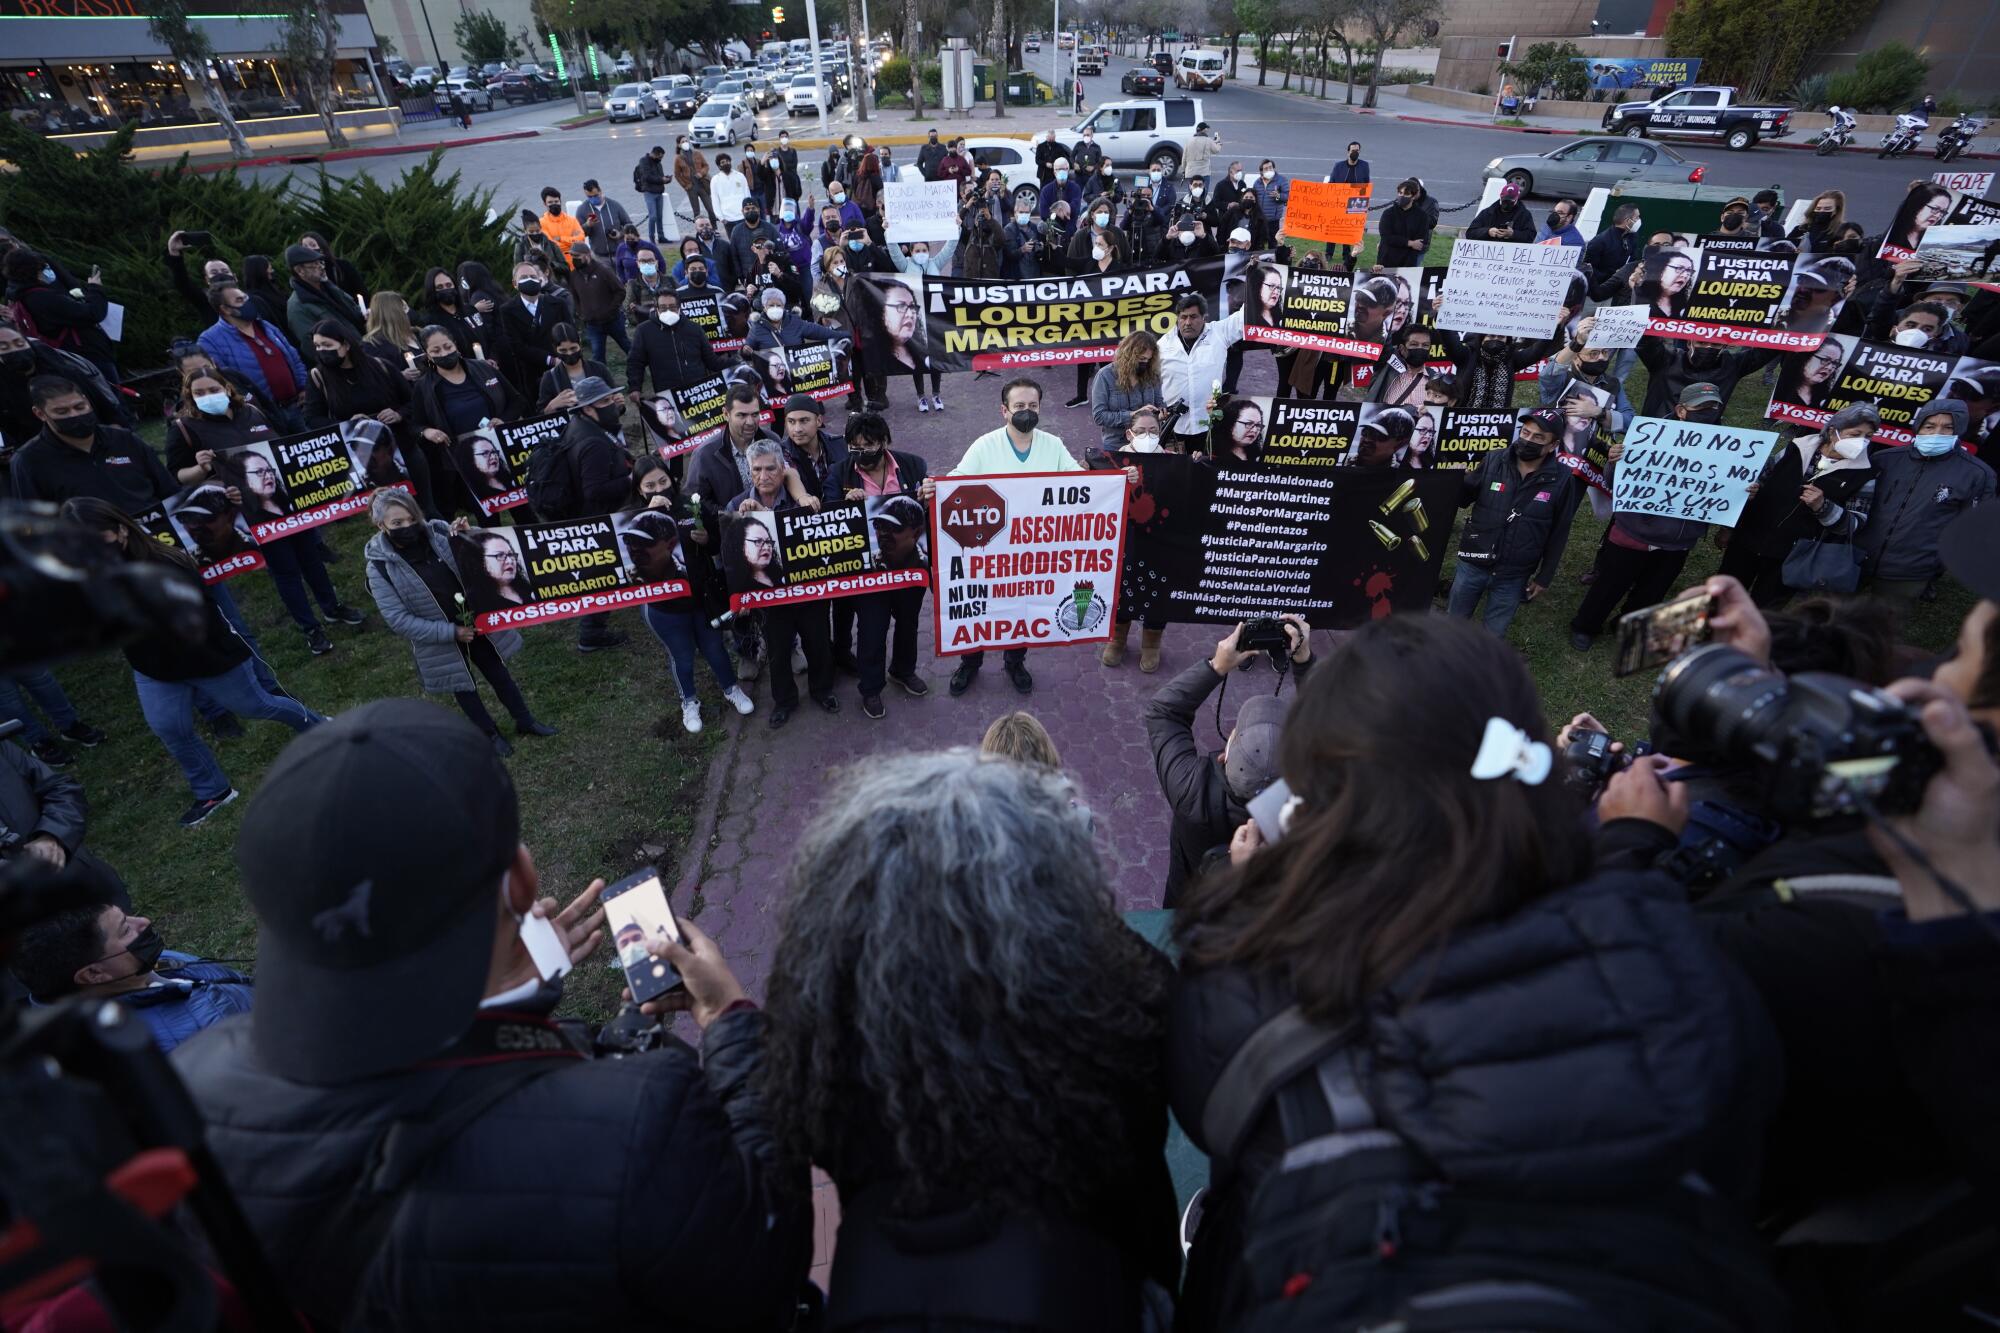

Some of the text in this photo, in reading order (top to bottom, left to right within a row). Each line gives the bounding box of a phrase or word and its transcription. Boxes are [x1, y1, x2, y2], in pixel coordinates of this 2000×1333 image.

[1651, 62, 1687, 72] ODISEA
[1650, 113, 1717, 124] POLICÍA MUNICIPAL
[1951, 173, 1991, 190] GOLPE
[1453, 259, 1468, 267] CON
[1457, 242, 1579, 267] MARINA DEL PILAR
[1707, 255, 1789, 271] ¡JUSTICIA
[1292, 271, 1350, 287] ¡JUSTICIA
[1451, 269, 1461, 277] TE
[1491, 275, 1525, 286] CIENTOS
[1723, 269, 1772, 281] PARA
[928, 270, 1192, 313] ¡JUSTICIA PARA
[1303, 286, 1338, 298] PARA
[1448, 288, 1469, 297] BAJA
[1516, 288, 1560, 298] CORAZONES
[1698, 281, 1782, 298] LOURDES
[683, 305, 709, 317] PARA
[955, 293, 1174, 327] LOURDES
[1287, 297, 1346, 313] LOURDES
[1729, 299, 1738, 307] Y
[1310, 312, 1317, 320] Y
[1688, 304, 1778, 325] MARGARITO!
[1284, 317, 1346, 335] MARGARITO!
[1647, 318, 1822, 347] YoSíSoyPeriodista
[1247, 326, 1380, 356] #YoSíSoyPeriodista
[1590, 333, 1636, 344] A PSN
[789, 344, 828, 363] ¡JUSTICIA
[800, 353, 823, 365] PARA
[1856, 346, 1948, 374] ¡JUSTICIA
[793, 361, 831, 377] LOURDES
[1870, 365, 1924, 385] PARA
[676, 377, 723, 404] ¡JUSTICIA
[795, 372, 834, 393] MARGARITO!
[1841, 376, 1933, 403] LOURDES
[690, 388, 718, 405] PARA
[1873, 396, 1882, 406] Y
[1277, 404, 1355, 425] ¡JUSTICIA
[1446, 412, 1513, 429] ¡JUSTICIA
[502, 416, 567, 447] ¡JUSTICIA
[1292, 422, 1338, 435] PARA
[1459, 425, 1499, 437] PARA
[278, 432, 340, 464] ¡JUSTICIA
[1270, 434, 1348, 449] LOURDES
[1441, 439, 1508, 451] LOURDES
[1673, 429, 1702, 448] NO
[1706, 433, 1764, 459] NOS
[297, 448, 335, 467] PARA
[1263, 453, 1344, 467] MARGARITO!
[1624, 449, 1718, 480] UNIMOS
[1727, 465, 1759, 483] NOS
[287, 457, 350, 487] LOURDES
[1217, 470, 1334, 489] #LourdesMaldonado
[1621, 468, 1725, 495] MATARAN
[295, 471, 363, 509] MARGARITO!
[318, 479, 325, 487] Y
[1042, 486, 1091, 506] A LOS
[1215, 487, 1331, 506] #MargaritoMartinez
[1659, 490, 1681, 507] X
[1684, 494, 1730, 512] UNO
[947, 508, 1000, 526] ALTO
[1210, 503, 1330, 522] #UnidosPorMargarito
[1614, 500, 1676, 515] PARQUE
[783, 506, 862, 536] ¡JUSTICIA
[1009, 512, 1118, 545] ASESINATOS
[1226, 520, 1308, 536] #Pendientazos
[524, 522, 610, 550] ¡JUSTICIA
[803, 522, 850, 541] PARA
[548, 536, 600, 555] PARA
[786, 535, 865, 562] LOURDES
[1200, 534, 1327, 553] #JusticiaParaMargarito
[531, 549, 617, 576] LOURDES
[788, 552, 871, 583] MARGARITO!
[821, 556, 830, 565] Y
[950, 549, 1113, 581] A PERIODISTAS
[1204, 551, 1319, 566] #JusticiaParaLourdes
[571, 571, 580, 580] Y
[1204, 566, 1311, 580] #NiSilencioNiOlvido
[538, 567, 627, 599] MARGARITO!
[740, 570, 922, 604] #YoSíSoyPeriodista
[948, 585, 964, 604] NI
[967, 584, 988, 599] UN
[992, 579, 1055, 599] MUERTO
[1199, 579, 1311, 594] #NoSeMataLaVerdad
[487, 582, 684, 626] #YoSíSoyPeriodista
[1170, 591, 1333, 609] #SinMásPeriodistasEnSusListas
[949, 600, 987, 620] MAS!
[951, 618, 1051, 646] ANPAC
